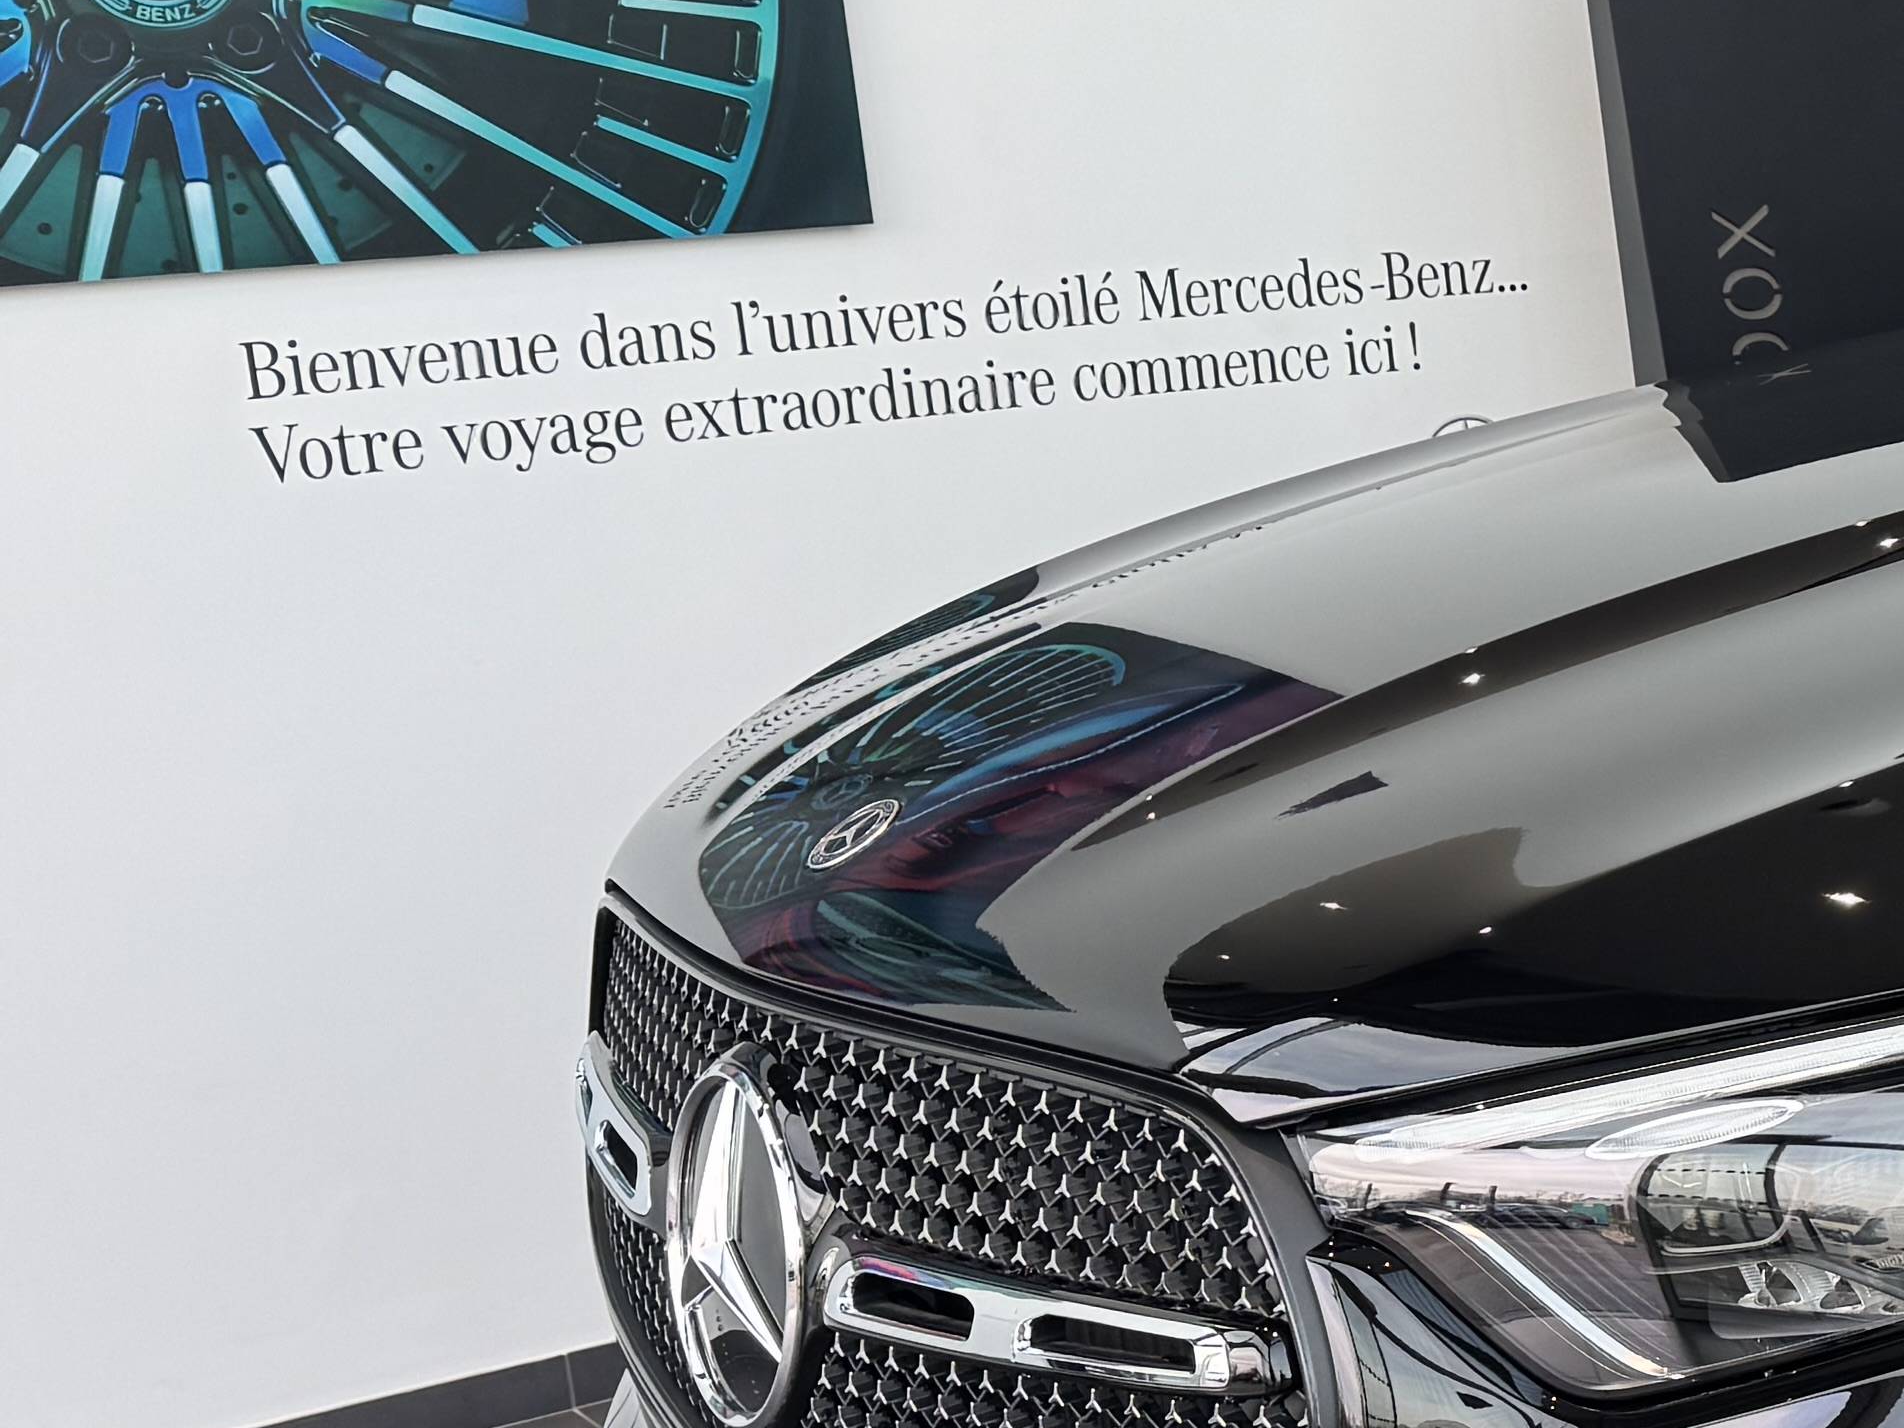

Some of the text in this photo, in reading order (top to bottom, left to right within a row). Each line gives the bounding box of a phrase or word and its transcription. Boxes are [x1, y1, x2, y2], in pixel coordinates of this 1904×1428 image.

[135, 3, 197, 23] BENZ
[239, 336, 559, 400] Bienvenue
[580, 312, 716, 370] dans
[985, 271, 1120, 334] étoilé
[249, 423, 424, 483] Votre
[441, 408, 644, 472] voyage
[664, 360, 1056, 444] extraordinaire
[1074, 344, 1330, 402] commence
